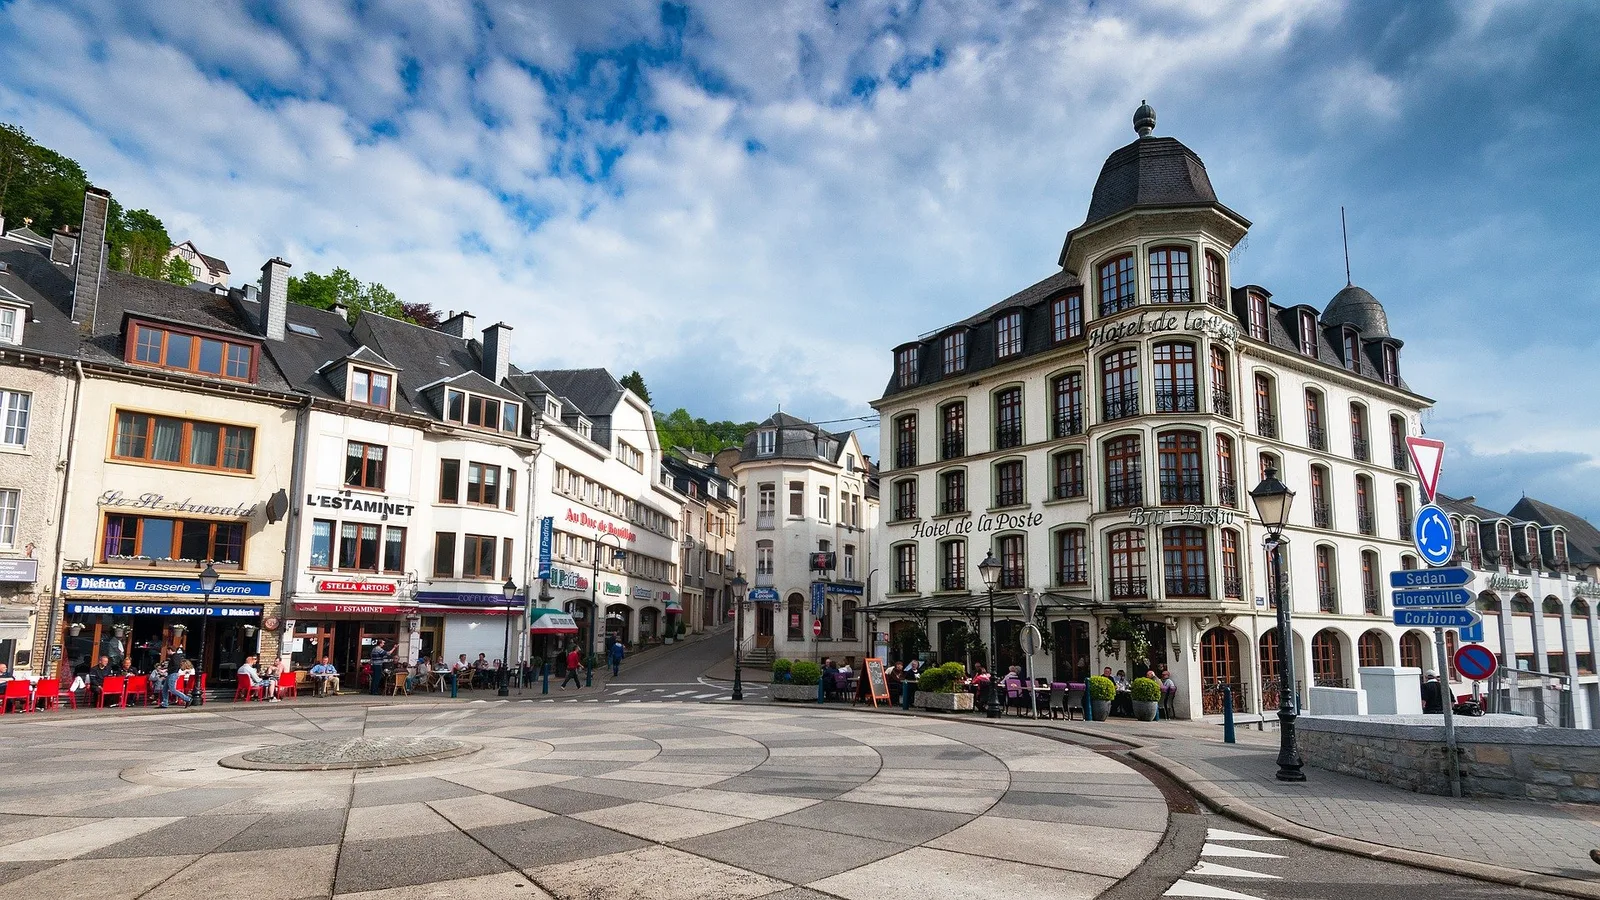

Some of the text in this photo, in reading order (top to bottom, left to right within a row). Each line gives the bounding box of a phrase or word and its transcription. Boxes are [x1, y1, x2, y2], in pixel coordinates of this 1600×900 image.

[1089, 311, 1148, 349] Hotel
[1149, 309, 1178, 333] de
[307, 494, 414, 516] L'ESTAMINET
[541, 518, 550, 547] Padrino
[565, 508, 637, 543] Au Duc de Bouillon
[911, 511, 1043, 539] Hotel de la Poste
[81, 577, 126, 589] Diekirch
[134, 581, 191, 592] Brasserie
[211, 585, 252, 594] averne
[1406, 572, 1446, 585] Sedan
[326, 582, 390, 592] STELLA ARTOIS
[1395, 591, 1462, 604] Florenville
[83, 605, 114, 614] Diekirch
[135, 606, 162, 614] SAINT
[172, 607, 213, 615] ARNOUD
[343, 605, 383, 613] ESTAMINET
[1405, 612, 1456, 624] Corbion
